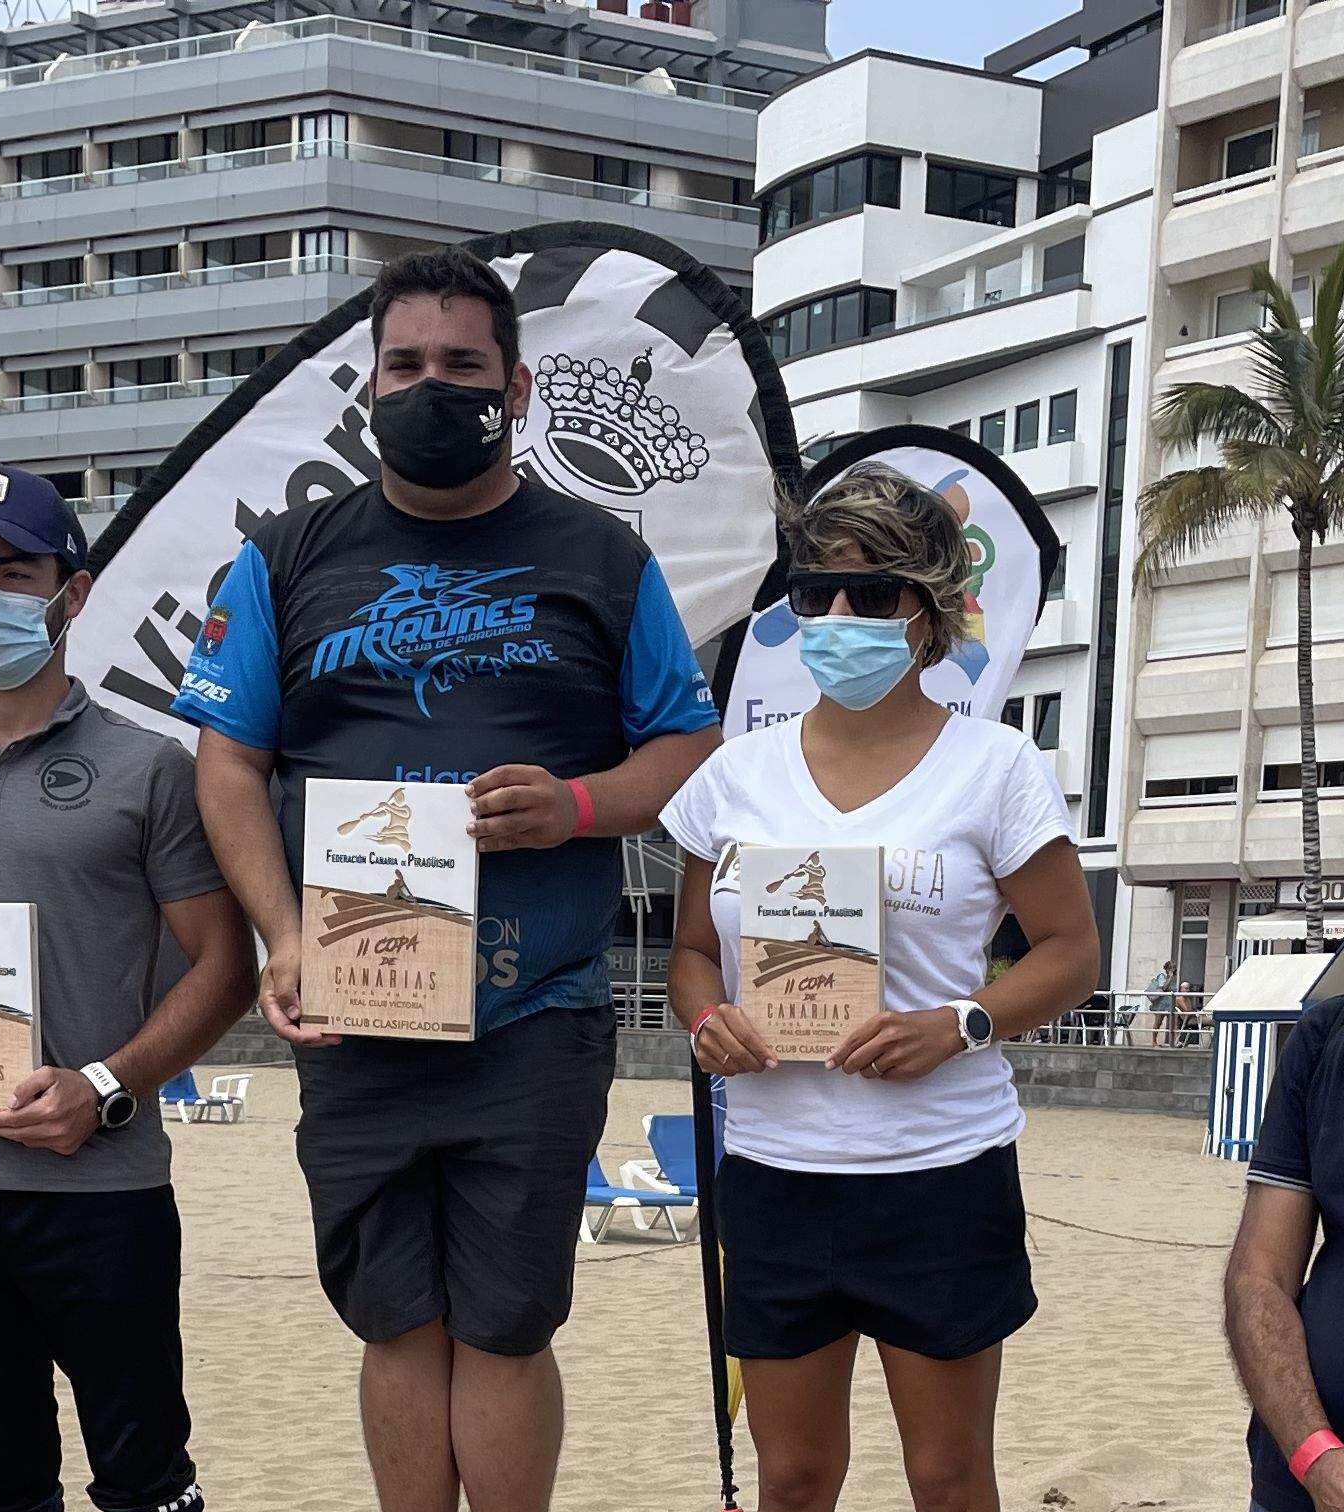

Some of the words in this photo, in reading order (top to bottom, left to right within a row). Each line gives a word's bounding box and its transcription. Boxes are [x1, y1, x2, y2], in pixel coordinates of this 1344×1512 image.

[310, 594, 538, 680] MARLINES
[398, 642, 433, 655] CLUB
[435, 638, 452, 649] DE
[432, 638, 560, 694] LANZAROTE
[883, 898, 941, 916] agüismo
[477, 916, 522, 947] ON
[373, 933, 420, 954] COPA
[378, 956, 398, 966] DE
[334, 966, 437, 991] CANARIAS
[798, 972, 836, 990] COPA
[767, 1003, 850, 1020] CANARIAS
[343, 1017, 370, 1028] CLUB
[372, 1018, 441, 1032] CLASIFICADO
[775, 1045, 797, 1054] CLUB
